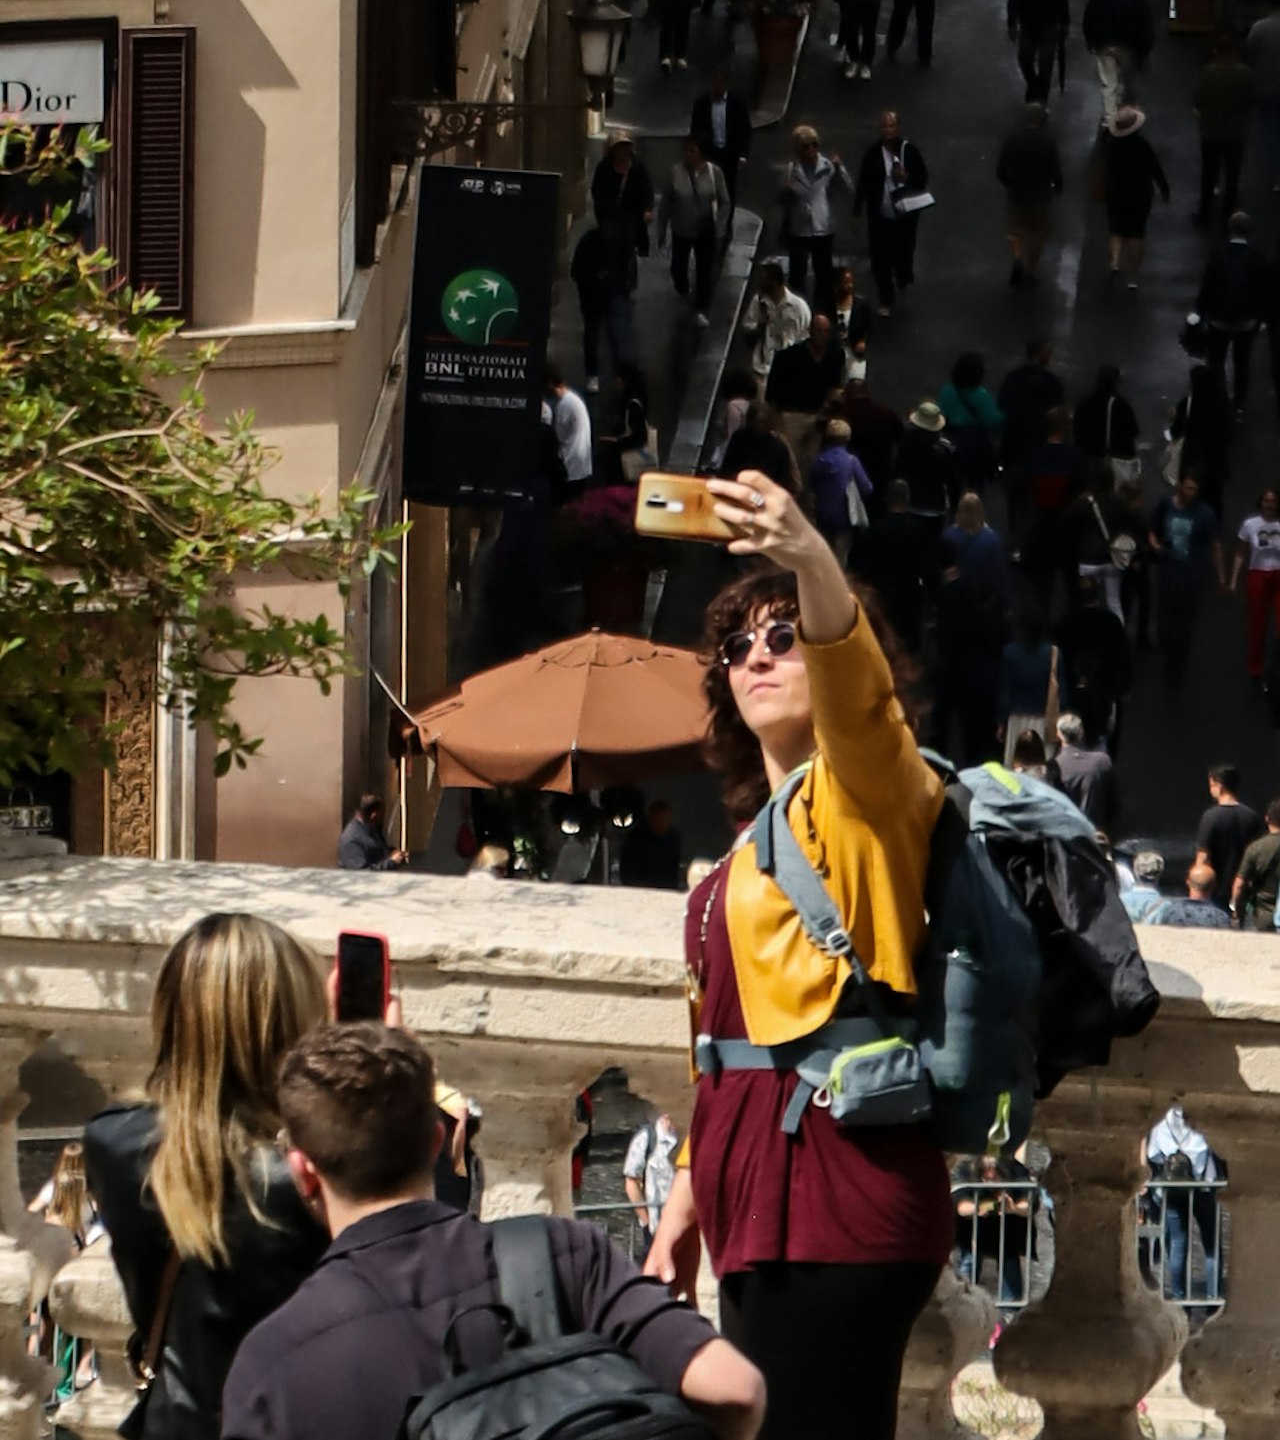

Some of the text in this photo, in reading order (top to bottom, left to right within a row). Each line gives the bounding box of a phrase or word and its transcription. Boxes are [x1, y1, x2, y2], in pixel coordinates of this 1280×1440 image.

[1, 81, 77, 113] Dior
[424, 361, 465, 376] BNL
[467, 365, 527, 380] D'ITALIA
